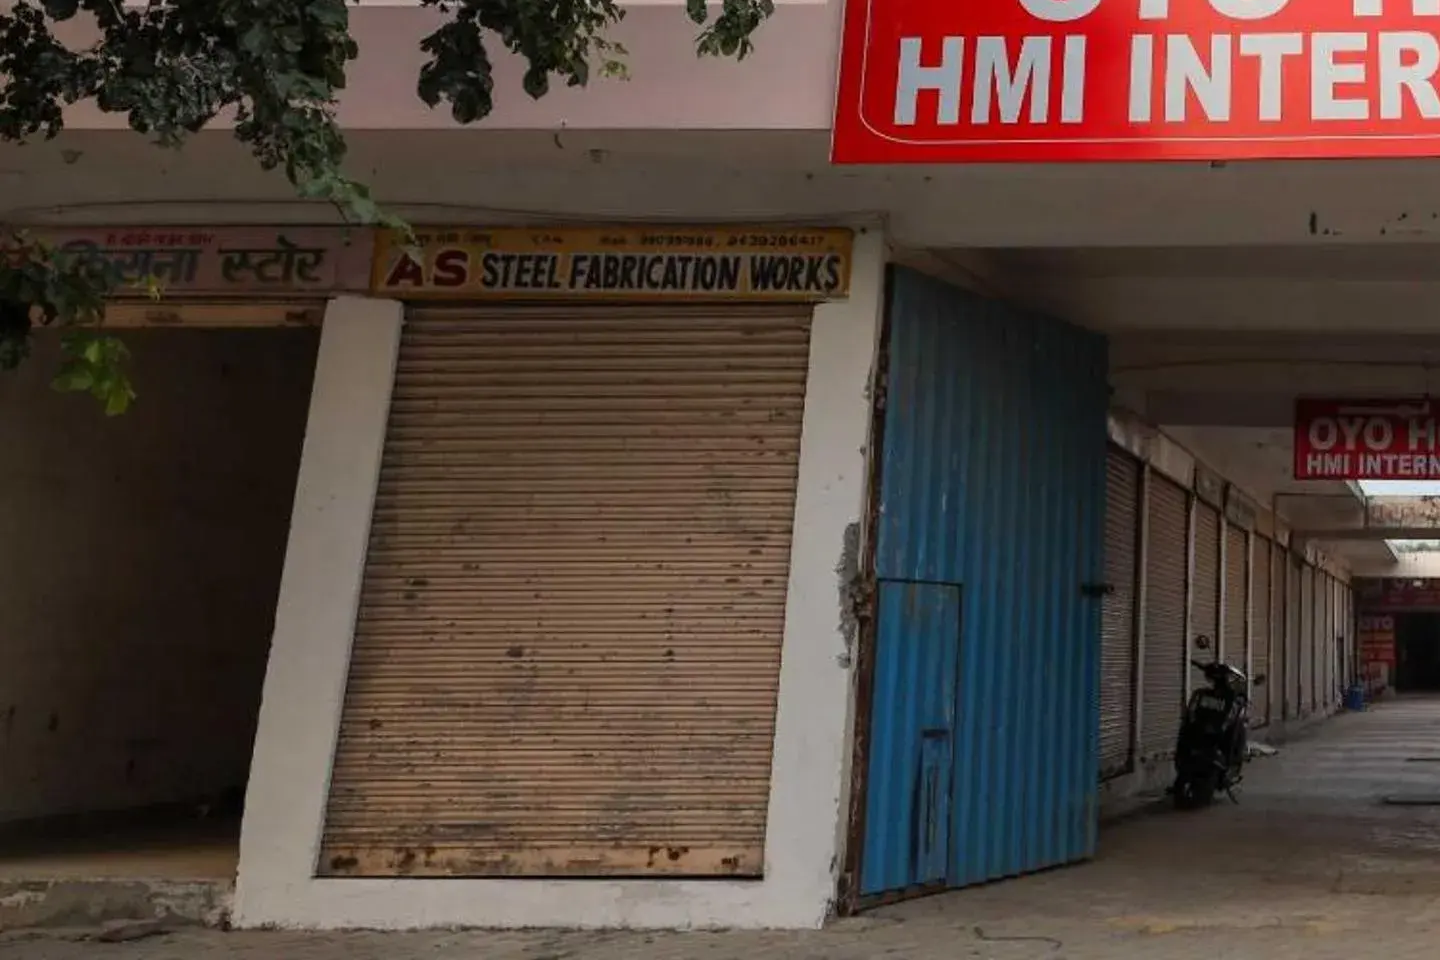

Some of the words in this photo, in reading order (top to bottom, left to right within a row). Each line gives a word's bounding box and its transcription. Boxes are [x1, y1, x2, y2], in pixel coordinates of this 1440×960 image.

[893, 36, 1086, 126] HMI
[219, 235, 327, 283] स्टोर
[482, 253, 560, 289] STEEL
[568, 254, 742, 291] FABRICATION
[750, 253, 841, 291] WORKS
[1308, 416, 1394, 451] OYO
[1306, 454, 1350, 476] HMI
